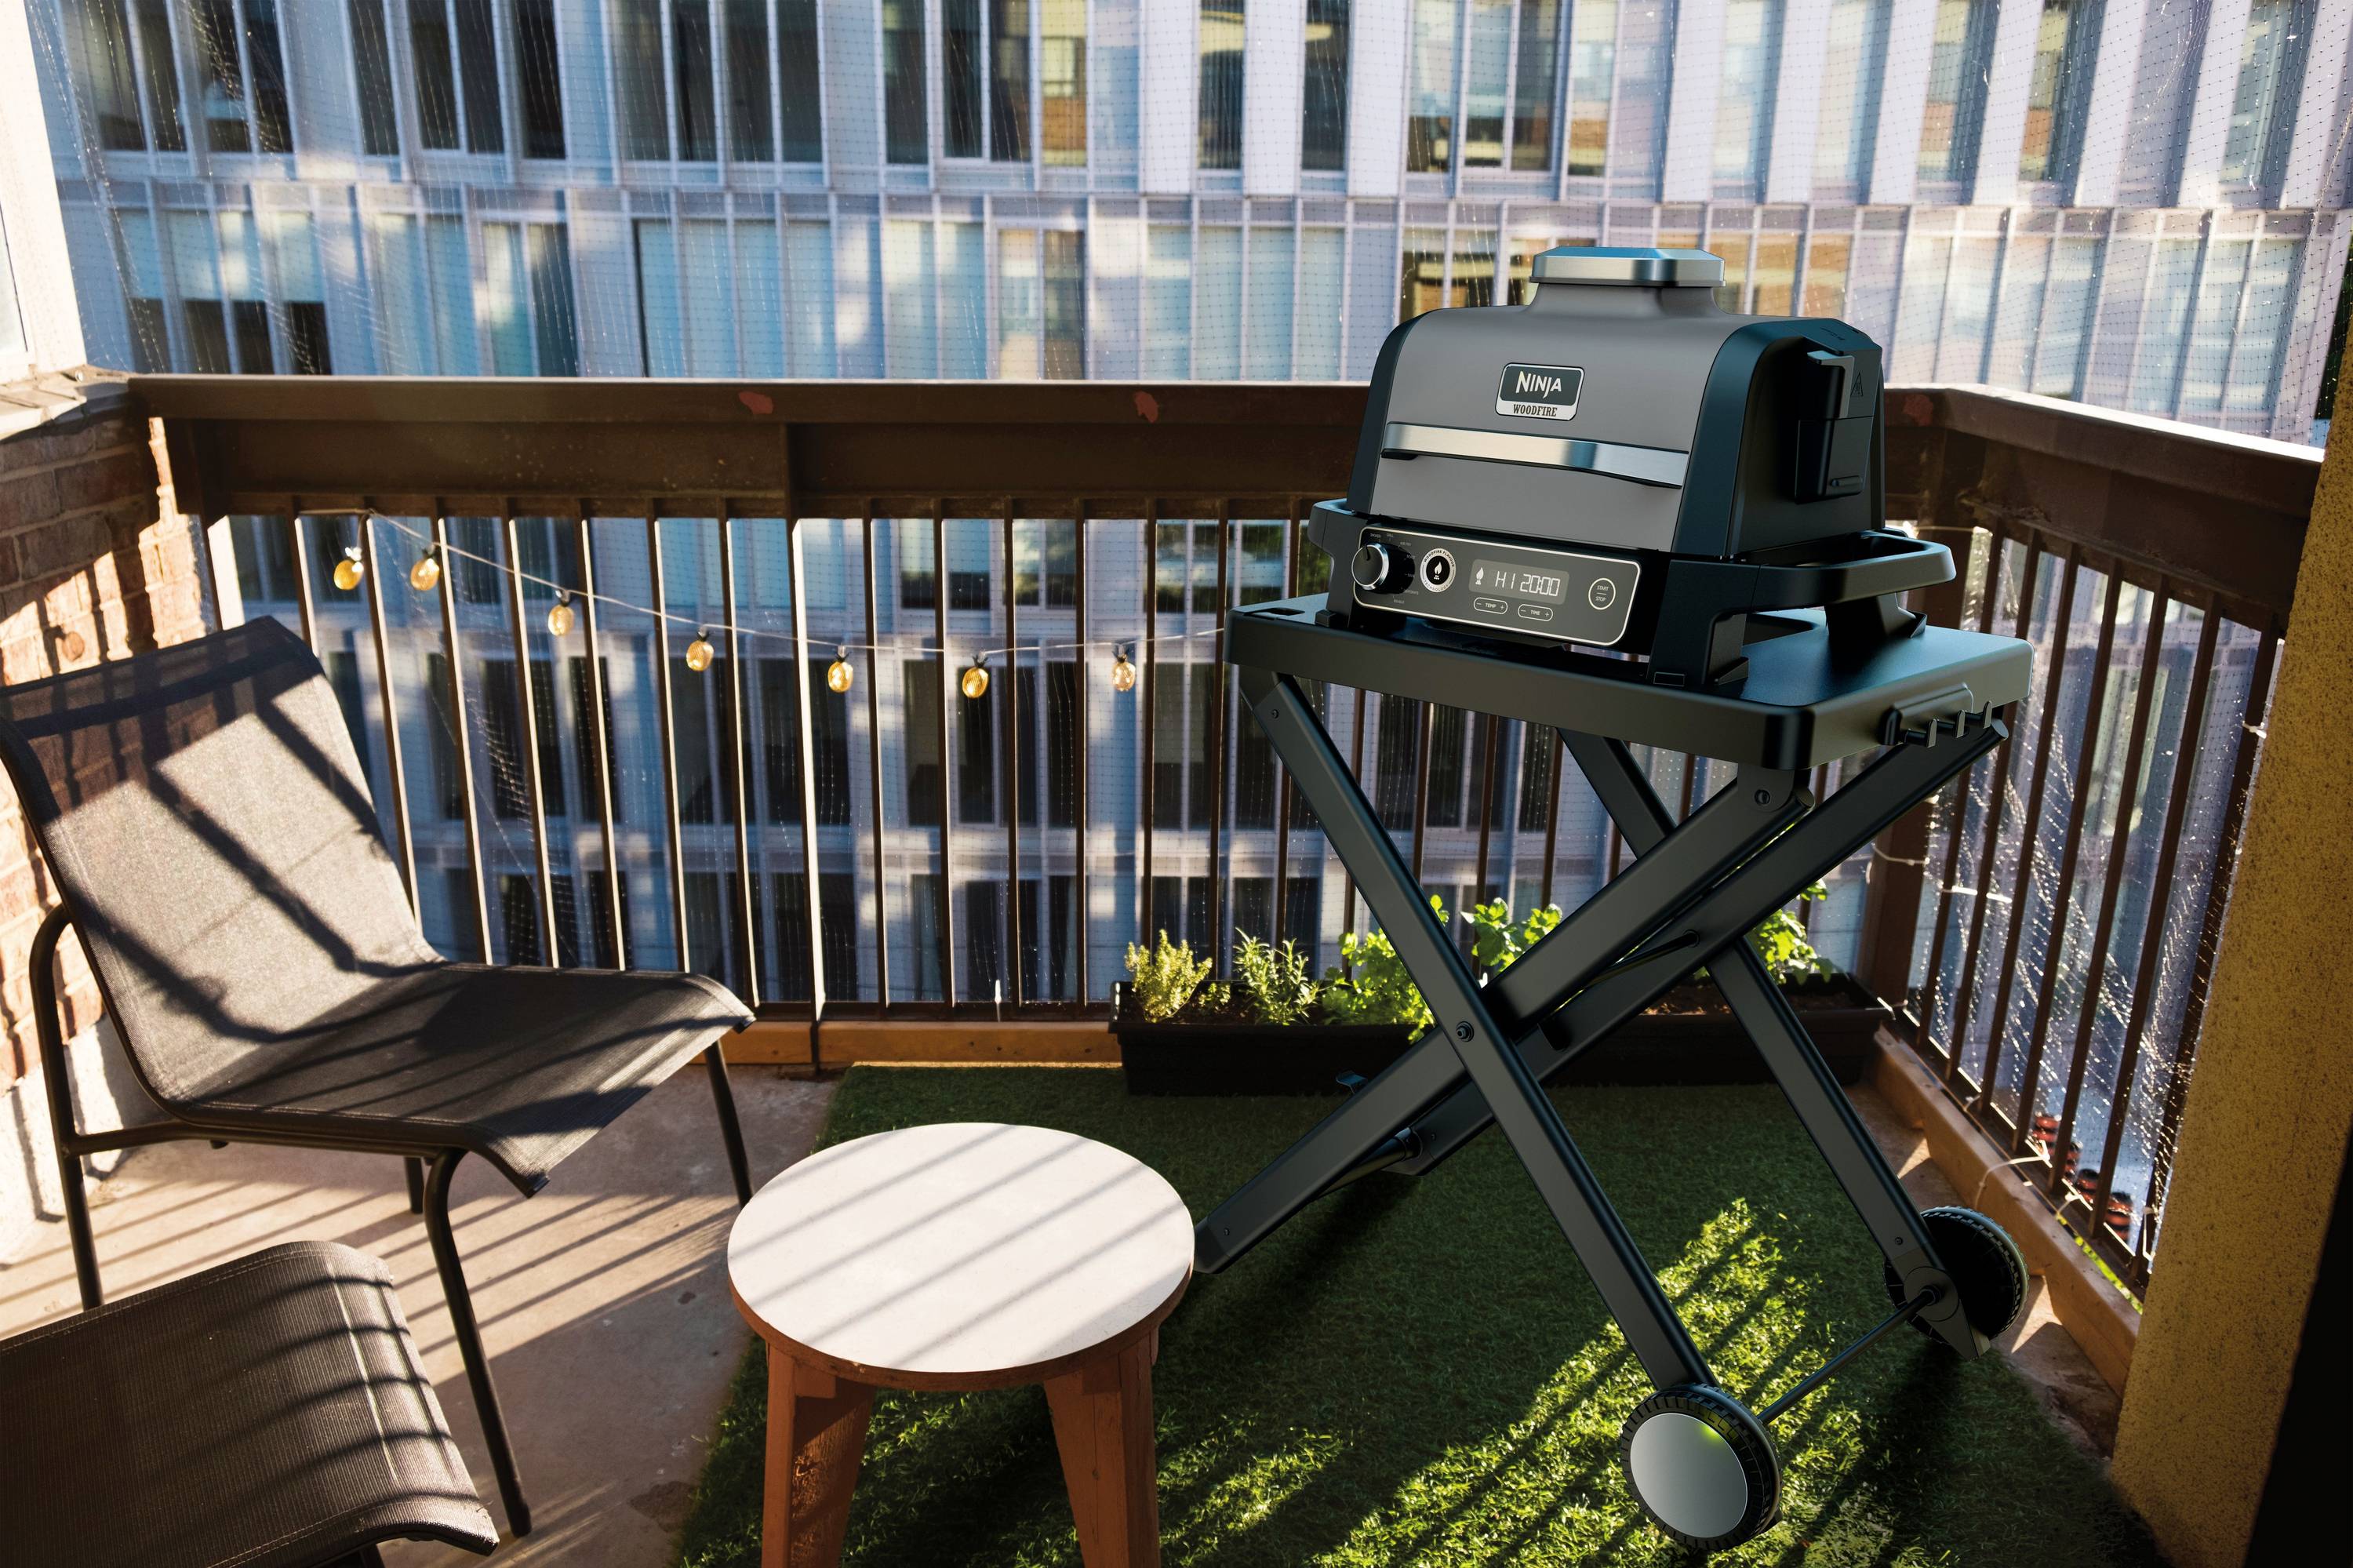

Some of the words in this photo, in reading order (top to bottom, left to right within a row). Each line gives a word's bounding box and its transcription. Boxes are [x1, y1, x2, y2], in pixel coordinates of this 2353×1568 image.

[1515, 371, 1562, 398] NINJA
[1513, 404, 1558, 417] WOODFIRE
[1519, 573, 1561, 596] 20:00
